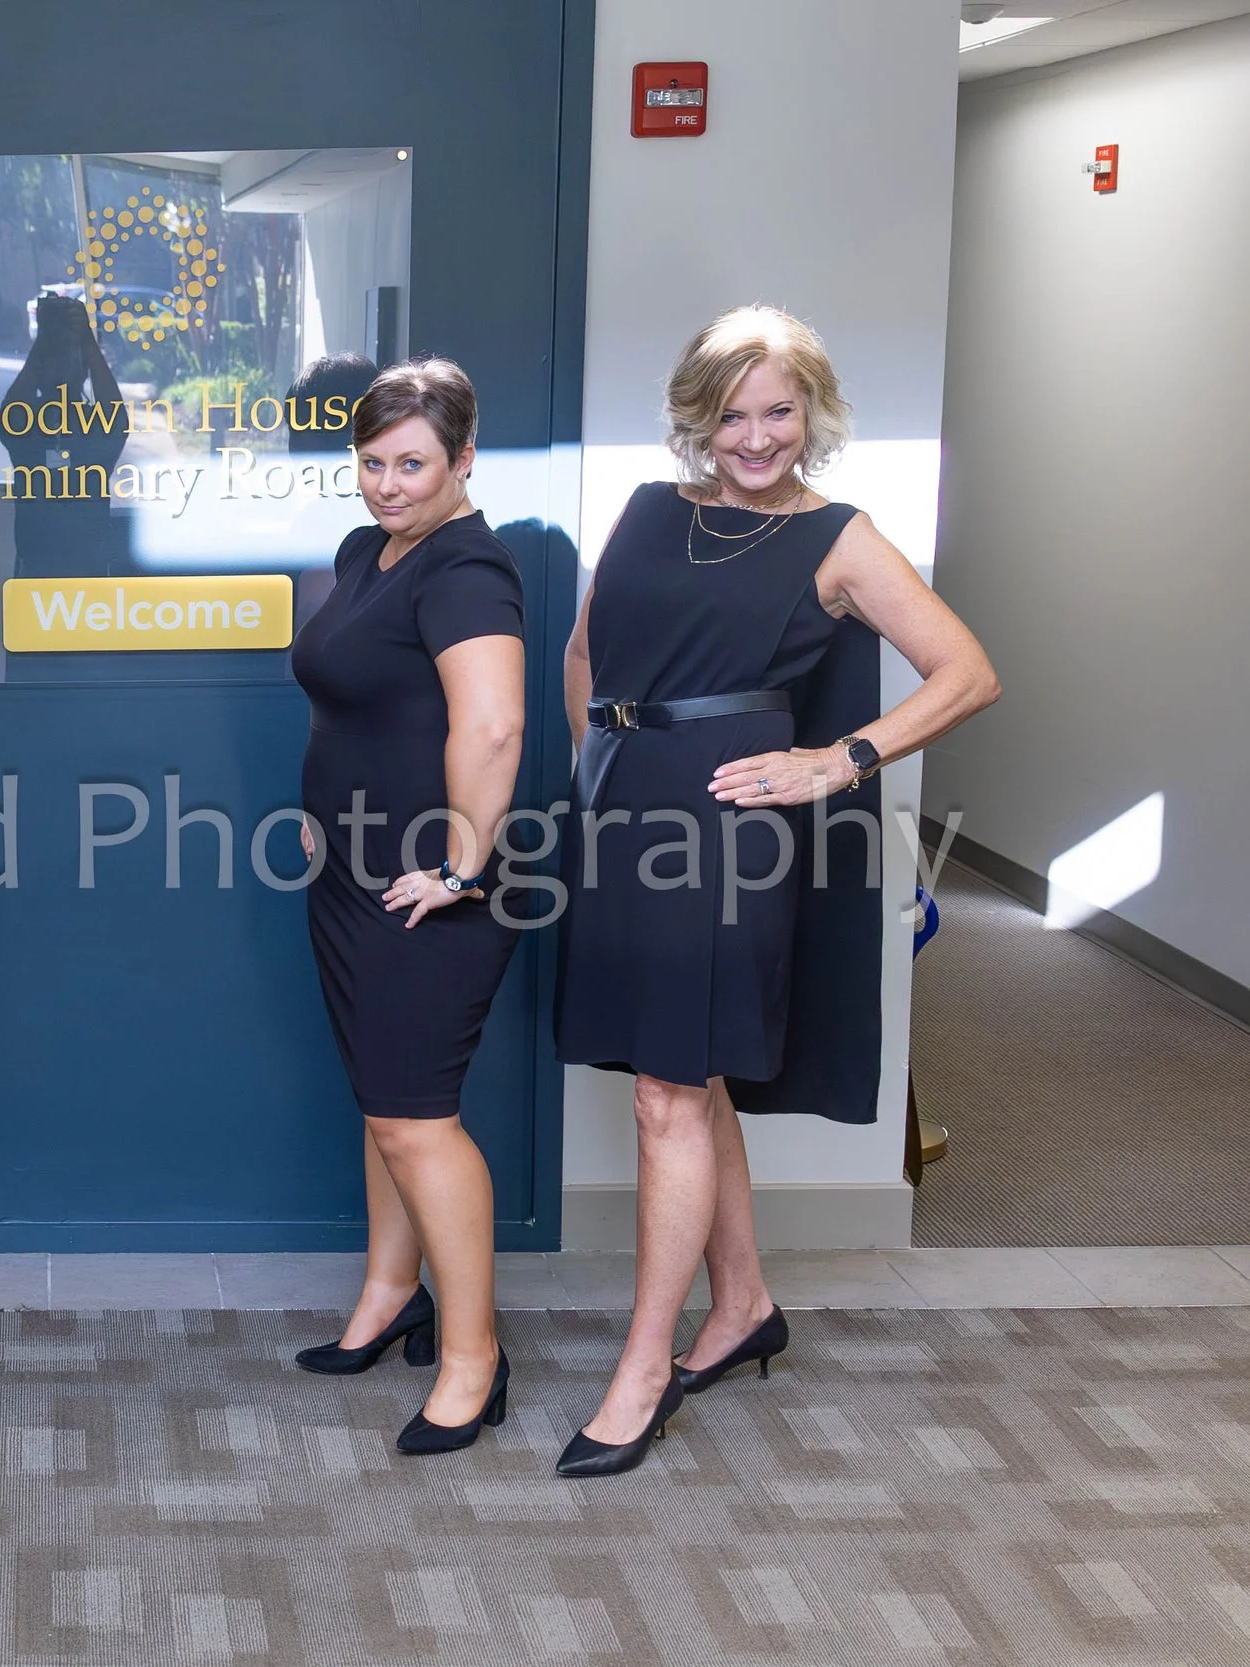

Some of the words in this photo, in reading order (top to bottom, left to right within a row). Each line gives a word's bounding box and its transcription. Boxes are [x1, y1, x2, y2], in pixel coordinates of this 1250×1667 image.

[675, 115, 698, 125] FIRE
[195, 380, 365, 432] Hous
[30, 587, 262, 631] Welcome
